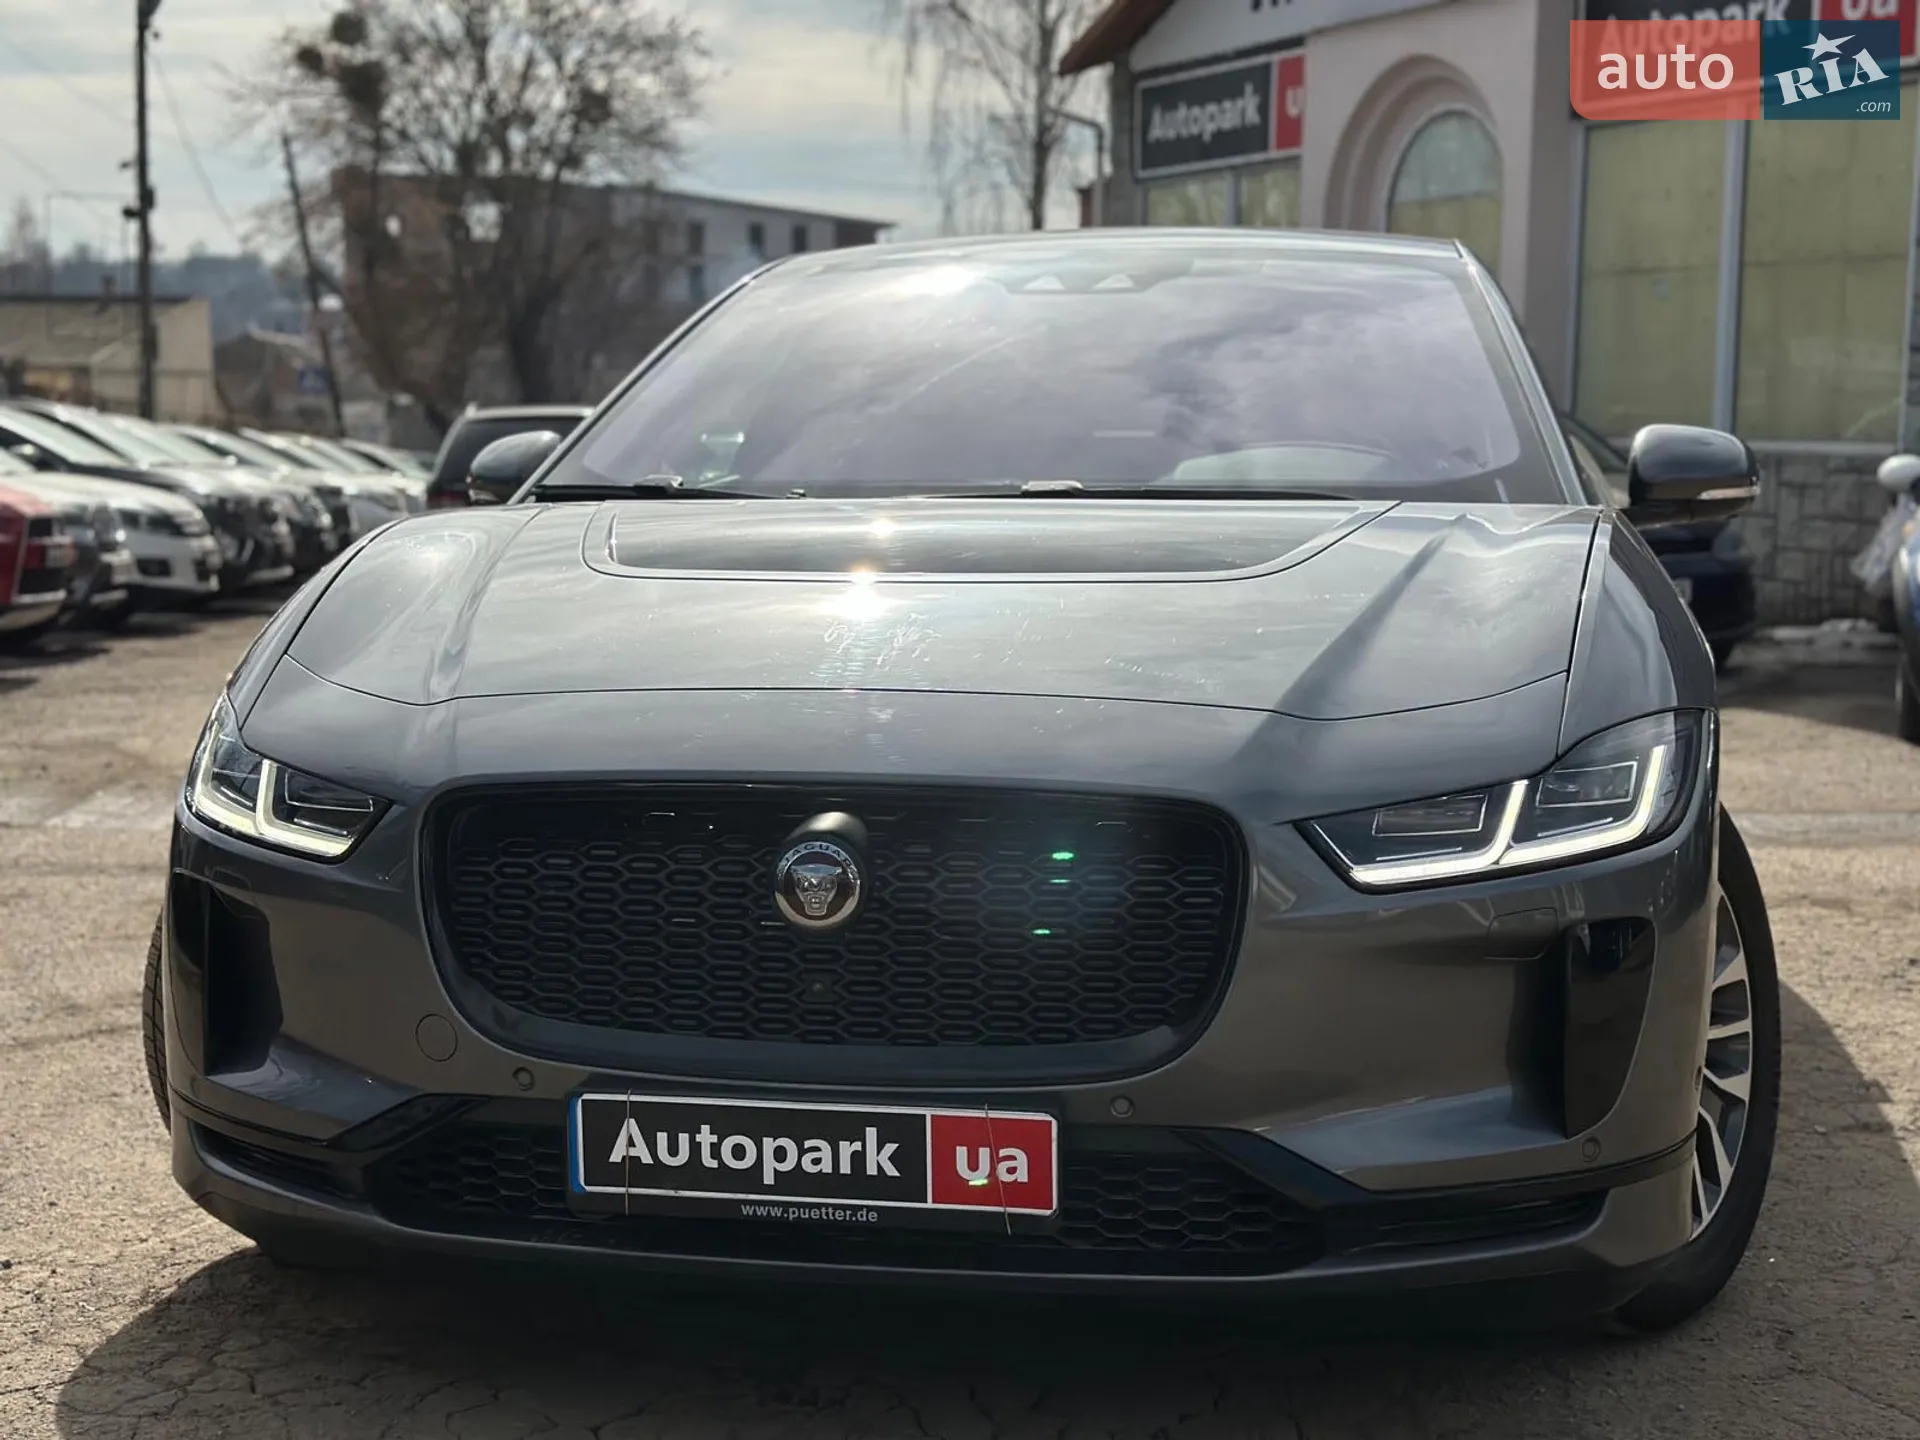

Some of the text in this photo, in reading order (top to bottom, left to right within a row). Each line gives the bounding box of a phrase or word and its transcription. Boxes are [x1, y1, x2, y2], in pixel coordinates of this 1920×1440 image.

[1147, 81, 1260, 143] Autopark
[609, 1118, 1029, 1185] Autopark ua
[741, 1204, 878, 1221] www.puetter.de
